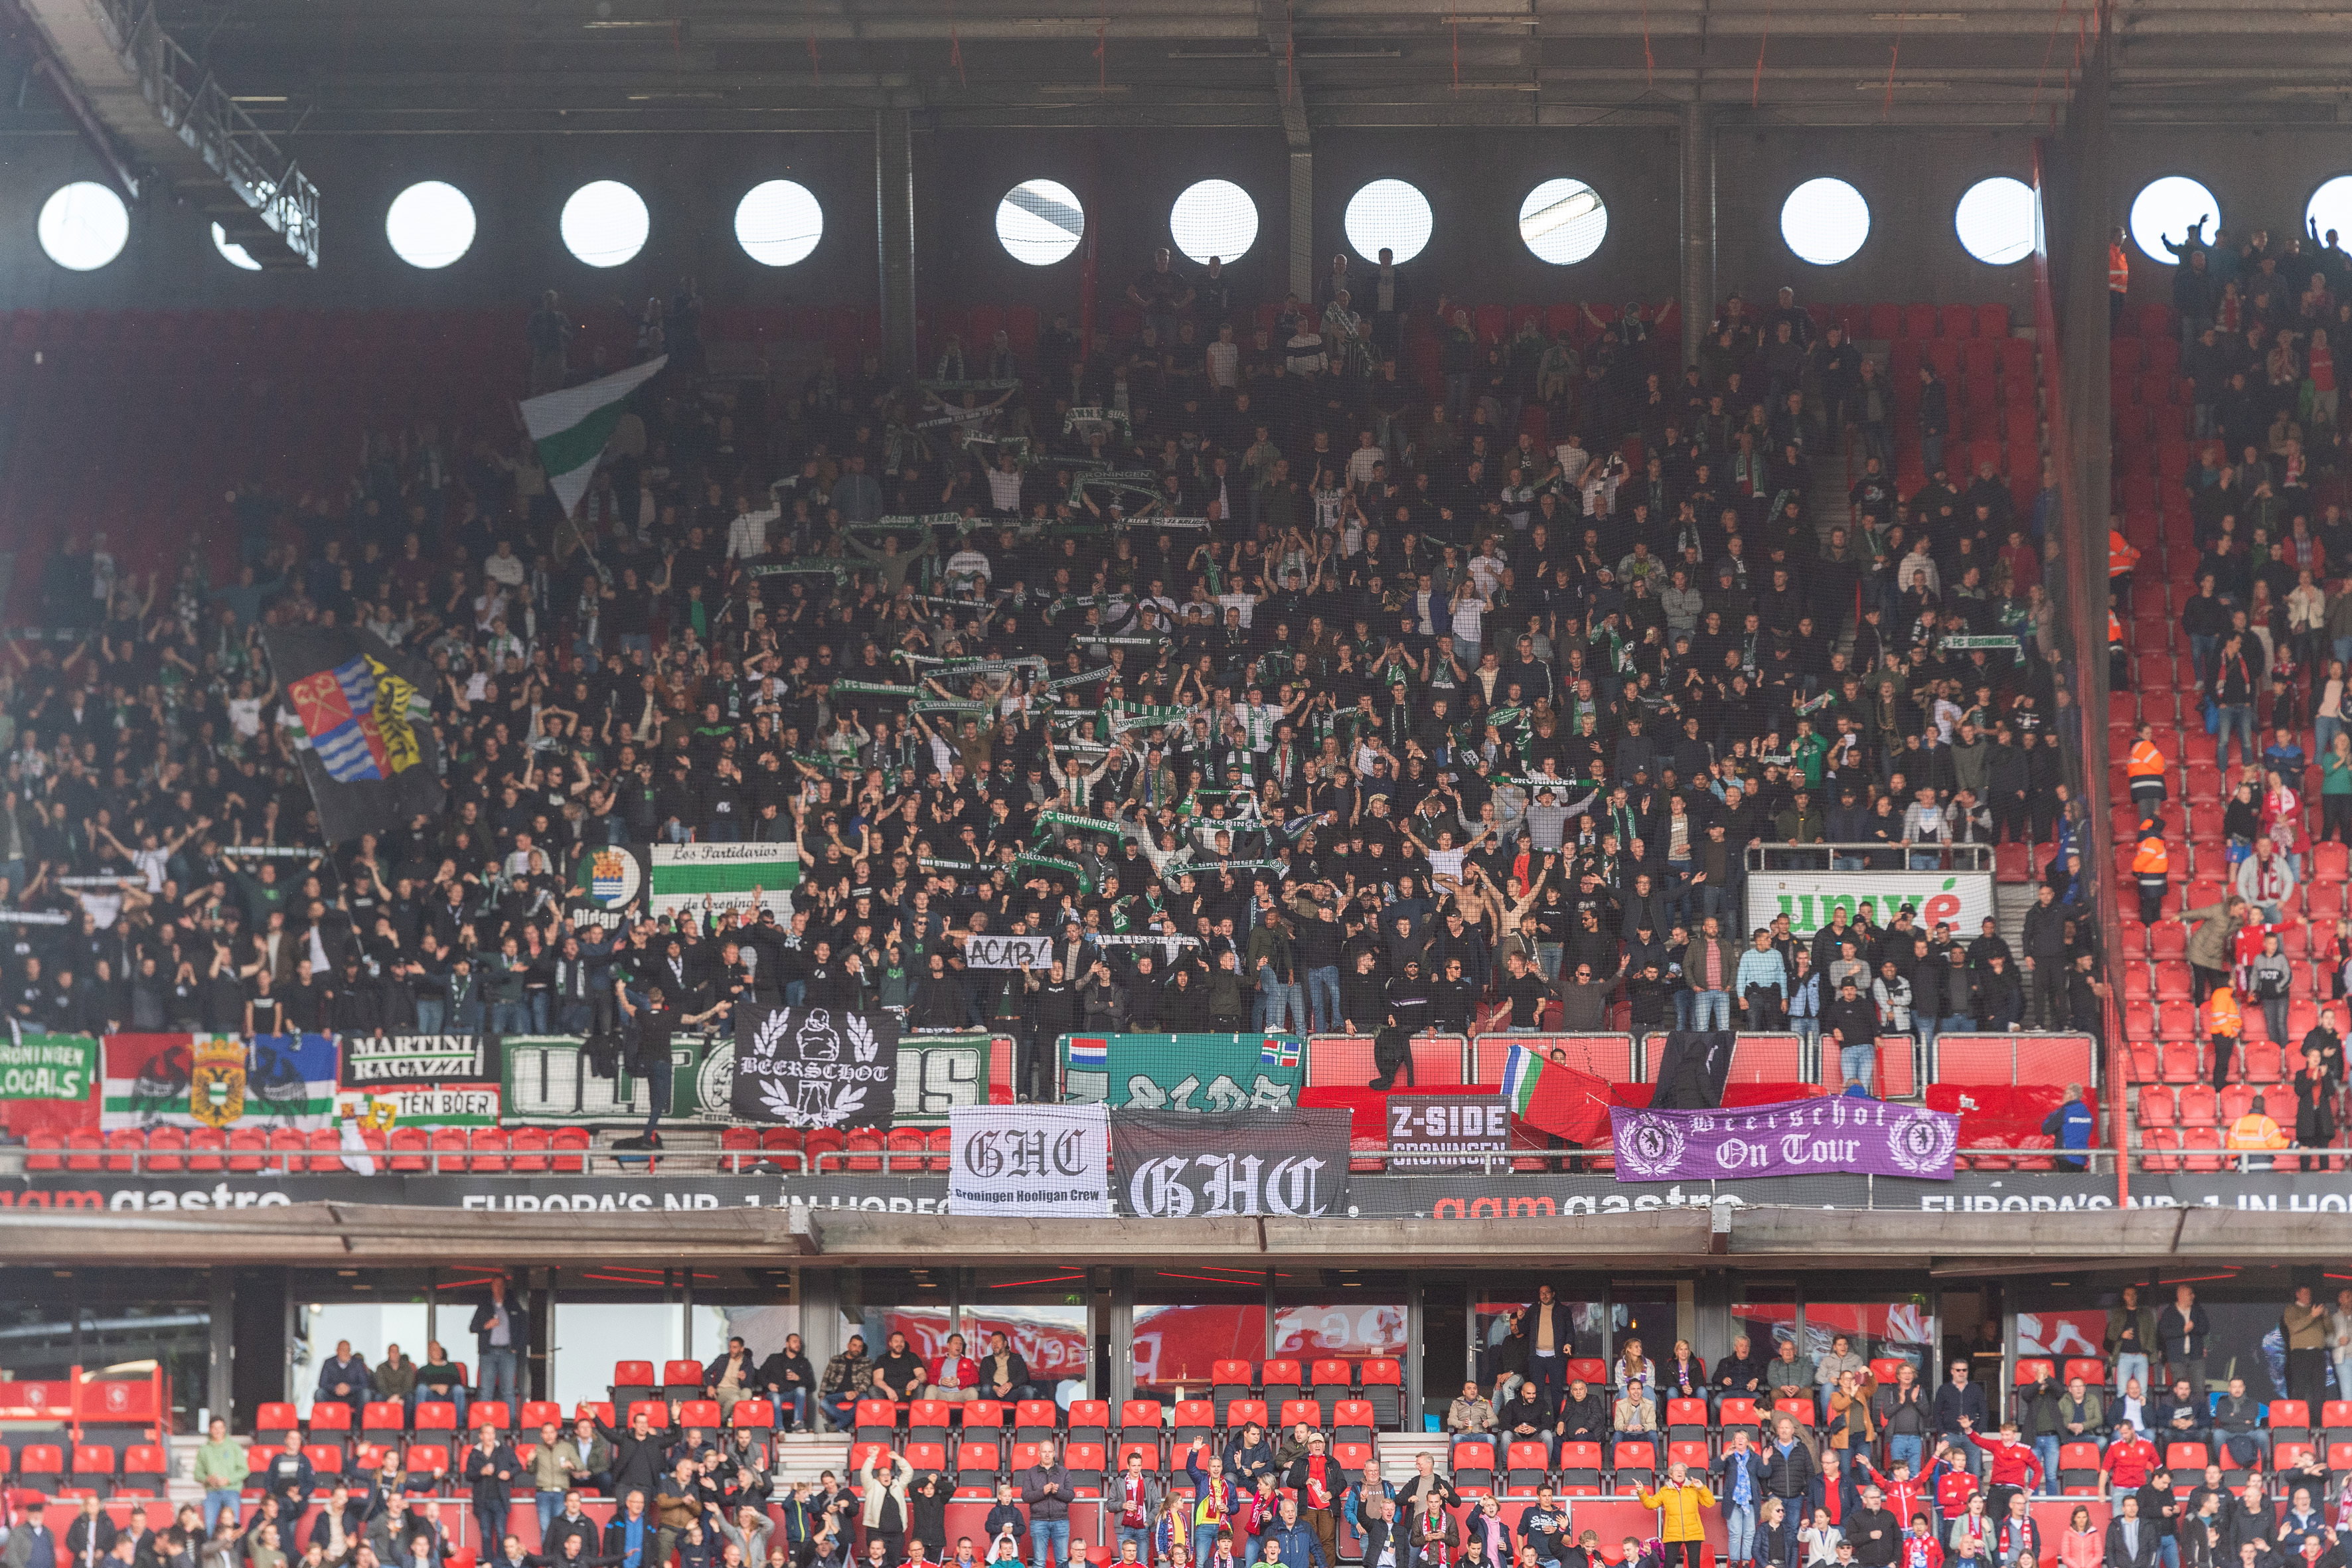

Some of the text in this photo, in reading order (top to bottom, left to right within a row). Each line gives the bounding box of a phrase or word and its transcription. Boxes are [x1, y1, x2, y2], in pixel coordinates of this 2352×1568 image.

[1062, 667, 1114, 685] GRONINGE
[860, 682, 916, 693] GRONINGEN
[1056, 812, 1121, 832] GRONINGEN
[672, 844, 778, 860] Los Partidarios
[1198, 859, 1264, 868] GROINGEN
[702, 896, 769, 913] Groningn
[574, 909, 642, 929] Oldamt
[968, 939, 1048, 967] ACAB!
[352, 1035, 473, 1055] MARTINI
[0, 1044, 85, 1067] RONINGEN
[353, 1060, 473, 1080] RAGAZZI
[740, 1056, 890, 1083] BEERSCHOT
[400, 1095, 489, 1113] TEN BOER
[1392, 1106, 1506, 1137] Z-SIDE
[1689, 1099, 1885, 1136] Beerschot
[965, 1129, 1088, 1178] GHC
[1393, 1142, 1506, 1166] GRONINGEN
[1715, 1132, 1861, 1169] On Tour
[955, 1188, 1099, 1203] Groningen Hooligan Crew
[1130, 1152, 1328, 1219] GHC
[2290, 1194, 2352, 1213] HO
